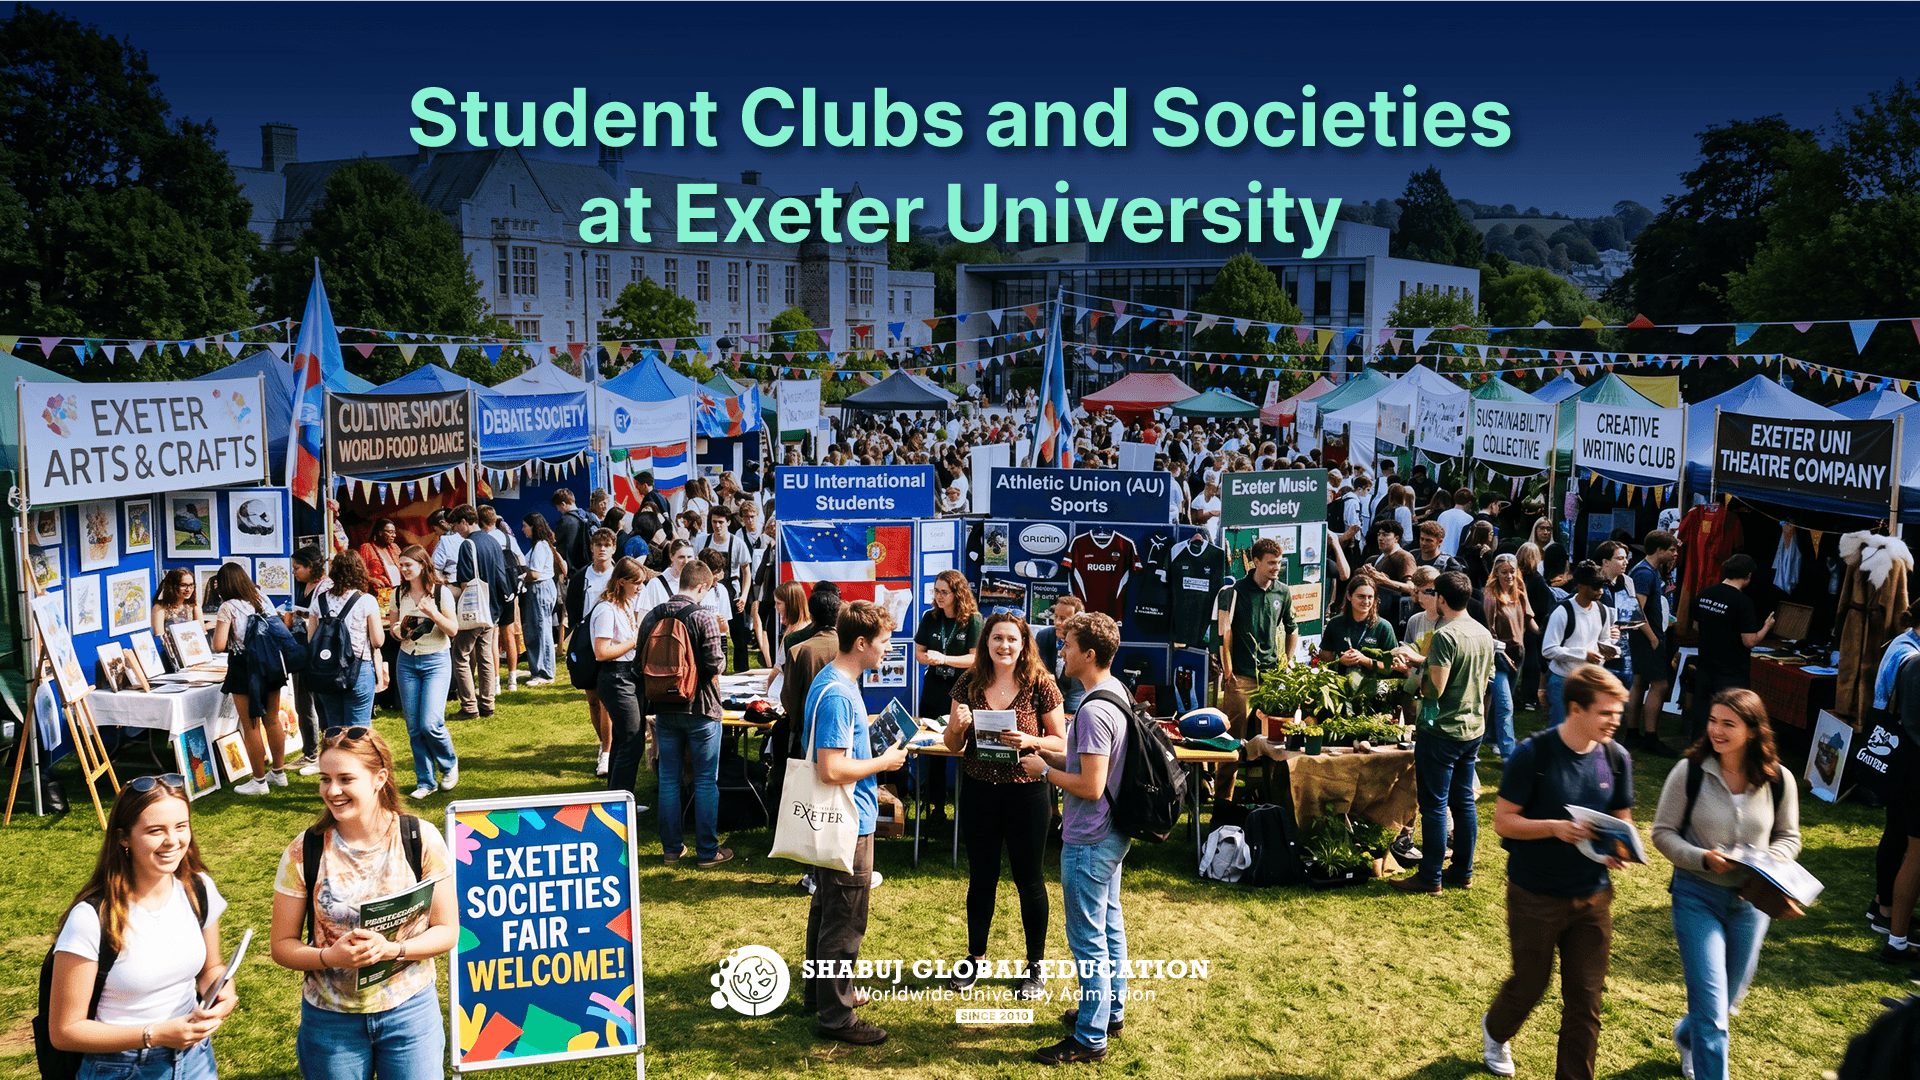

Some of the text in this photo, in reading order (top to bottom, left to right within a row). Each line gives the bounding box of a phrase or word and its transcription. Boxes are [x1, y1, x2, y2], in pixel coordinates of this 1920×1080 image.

[91, 397, 208, 437] EXETER
[338, 399, 464, 433] CULTURE SHOCK:
[482, 404, 585, 435] DEBATE SOCIETY
[1476, 408, 1552, 434] SUSTAINABILITY
[1597, 413, 1660, 438] CREATIVE
[338, 431, 465, 463] WORLD FOOD & DANCE
[1482, 434, 1540, 460] COLLECTIVE
[1582, 438, 1676, 469] WRITING CLUB
[1750, 423, 1852, 455] EXETER UNI
[43, 435, 257, 488] ARTS & CRAFTS
[1720, 449, 1887, 490] THEATRE COMPANY
[783, 472, 926, 489] EU International
[996, 474, 1165, 497] Athletic Union (AU)
[1231, 476, 1318, 496] Exeter Music
[815, 495, 895, 511] Students
[1050, 496, 1108, 515] Sports
[1250, 499, 1301, 519] Society
[1087, 563, 1117, 572] RUGBY
[792, 801, 844, 831] EXETER
[487, 842, 599, 880] EXETER
[467, 875, 621, 919] SOCIETIES
[502, 916, 569, 952] FAIR
[467, 947, 625, 992] WELCOME!
